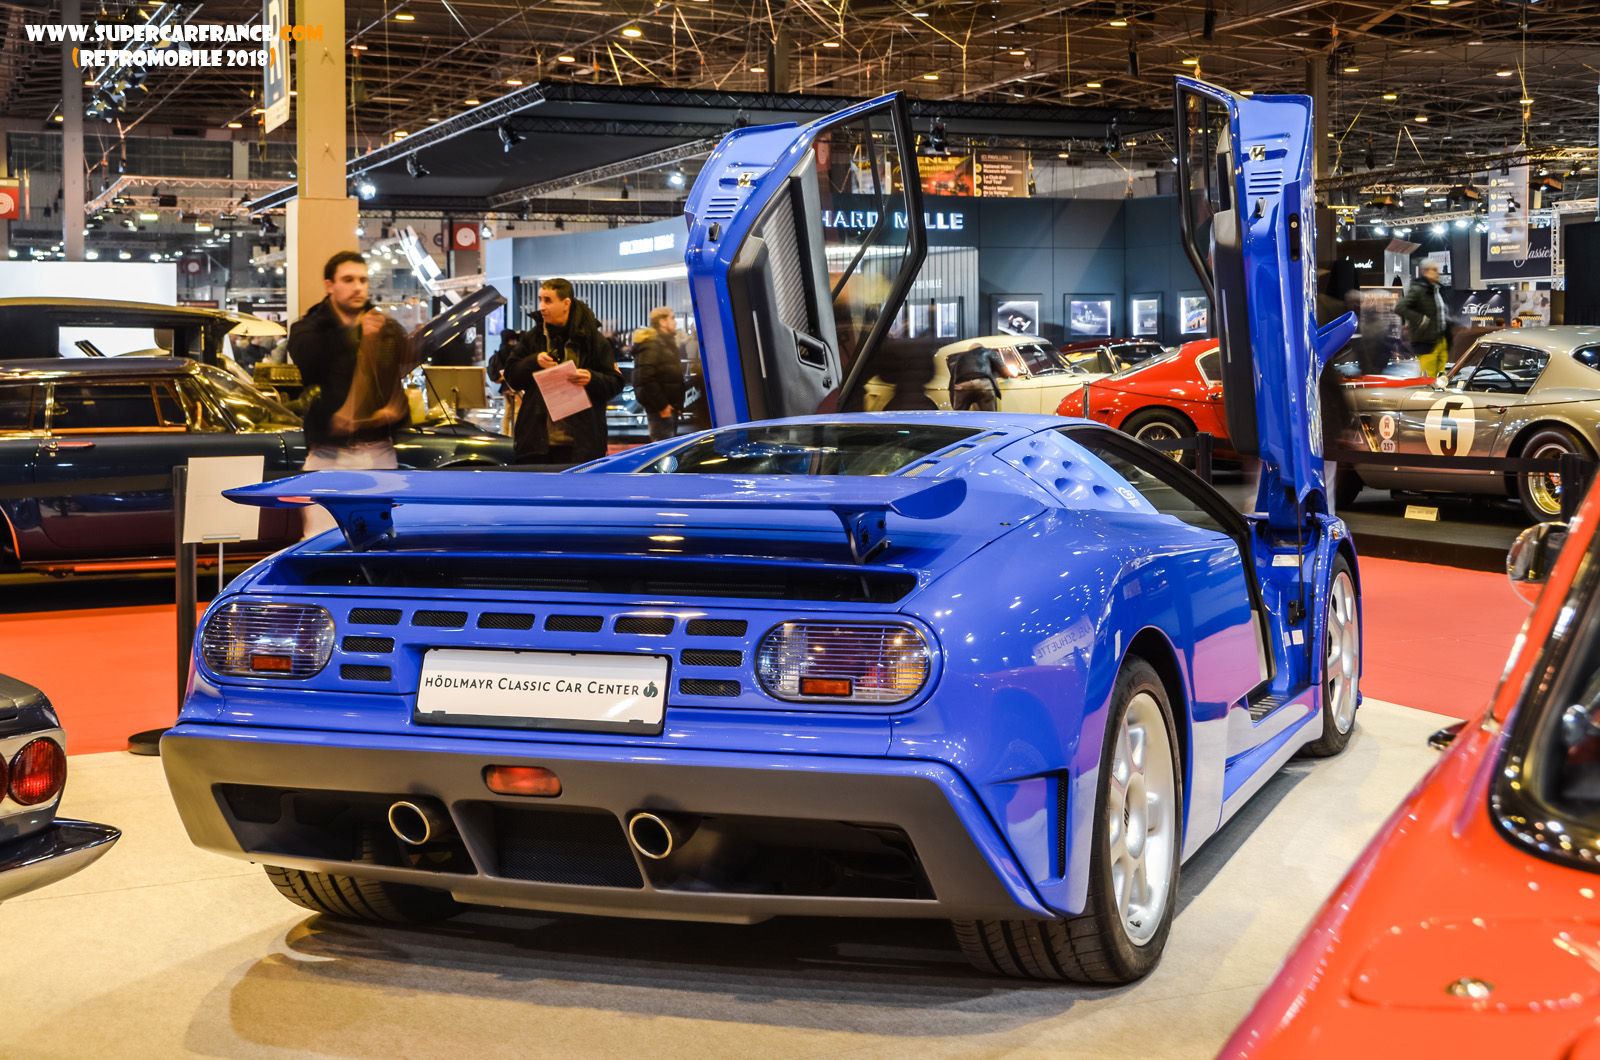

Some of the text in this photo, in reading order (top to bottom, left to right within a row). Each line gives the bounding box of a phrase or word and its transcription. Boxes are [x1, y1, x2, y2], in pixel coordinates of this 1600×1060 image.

[894, 212, 964, 230] MLLE
[1440, 402, 1463, 457] 5
[1383, 442, 1393, 451] 257
[425, 675, 493, 689] HÖDLMAYR
